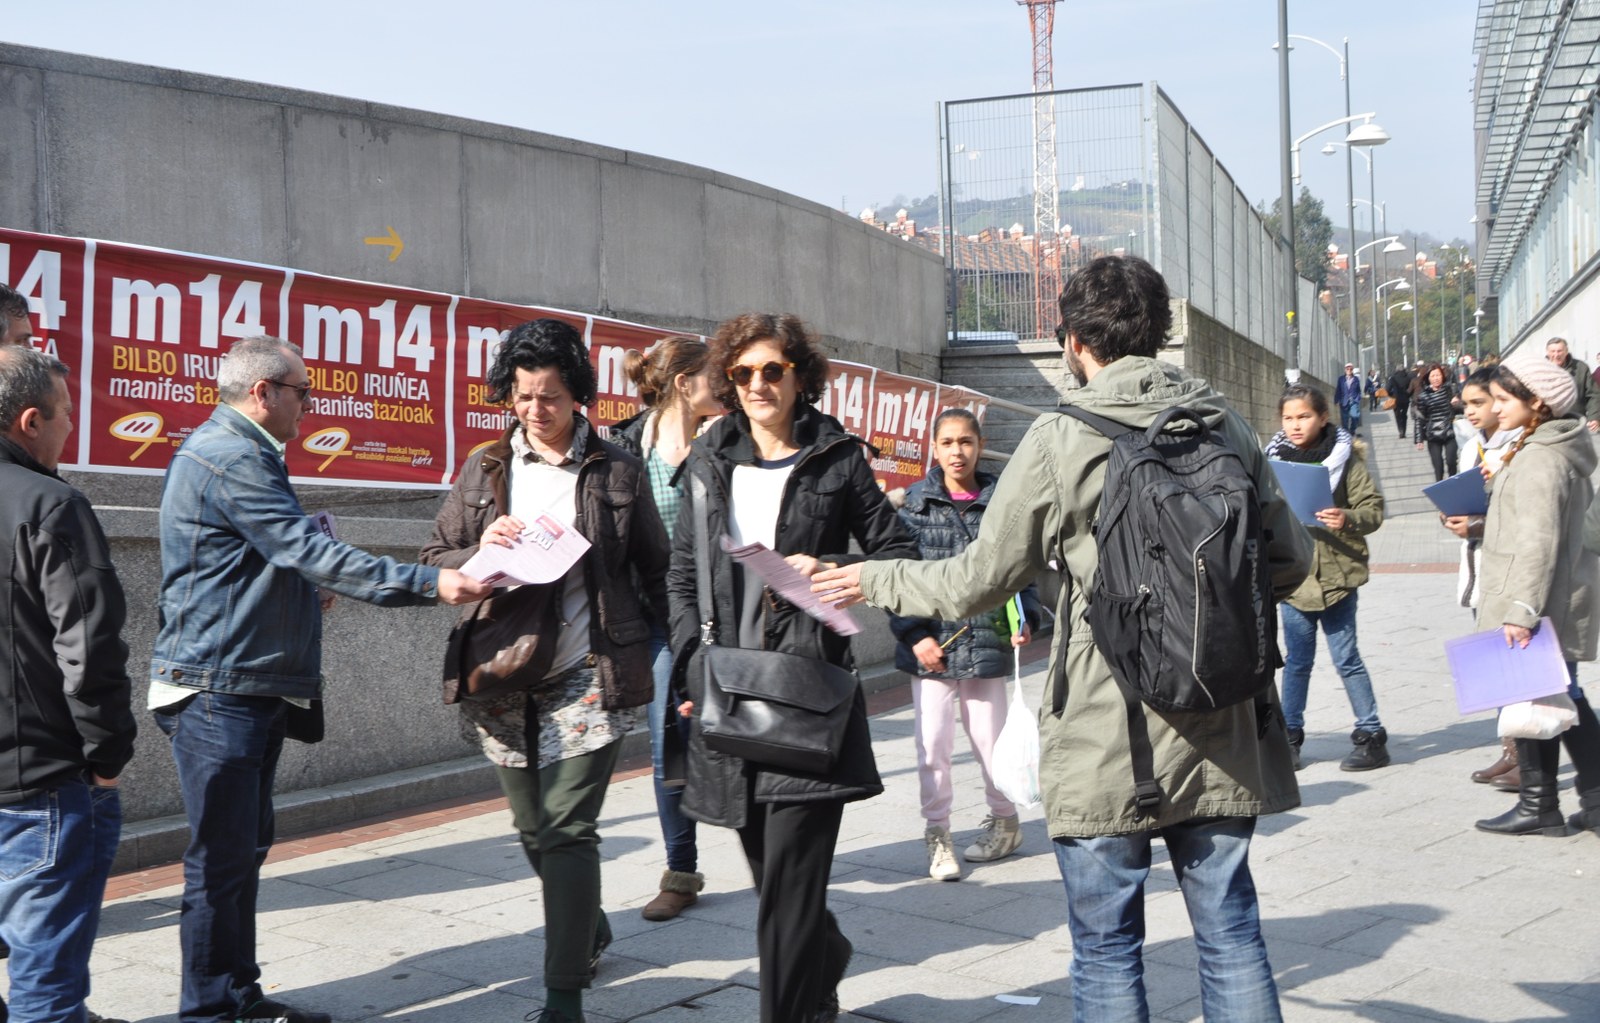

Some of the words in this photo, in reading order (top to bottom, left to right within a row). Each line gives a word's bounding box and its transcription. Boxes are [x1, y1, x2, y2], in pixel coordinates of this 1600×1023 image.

[110, 273, 266, 348] m14
[302, 298, 435, 373] m14
[112, 345, 177, 376] BILBO
[305, 366, 358, 394] BILBO
[364, 371, 430, 401] IRUÑEA
[309, 394, 434, 424] manifestazioak
[598, 399, 636, 421] BILBO
[875, 386, 930, 439] m14
[895, 438, 921, 460] IRUÑEA
